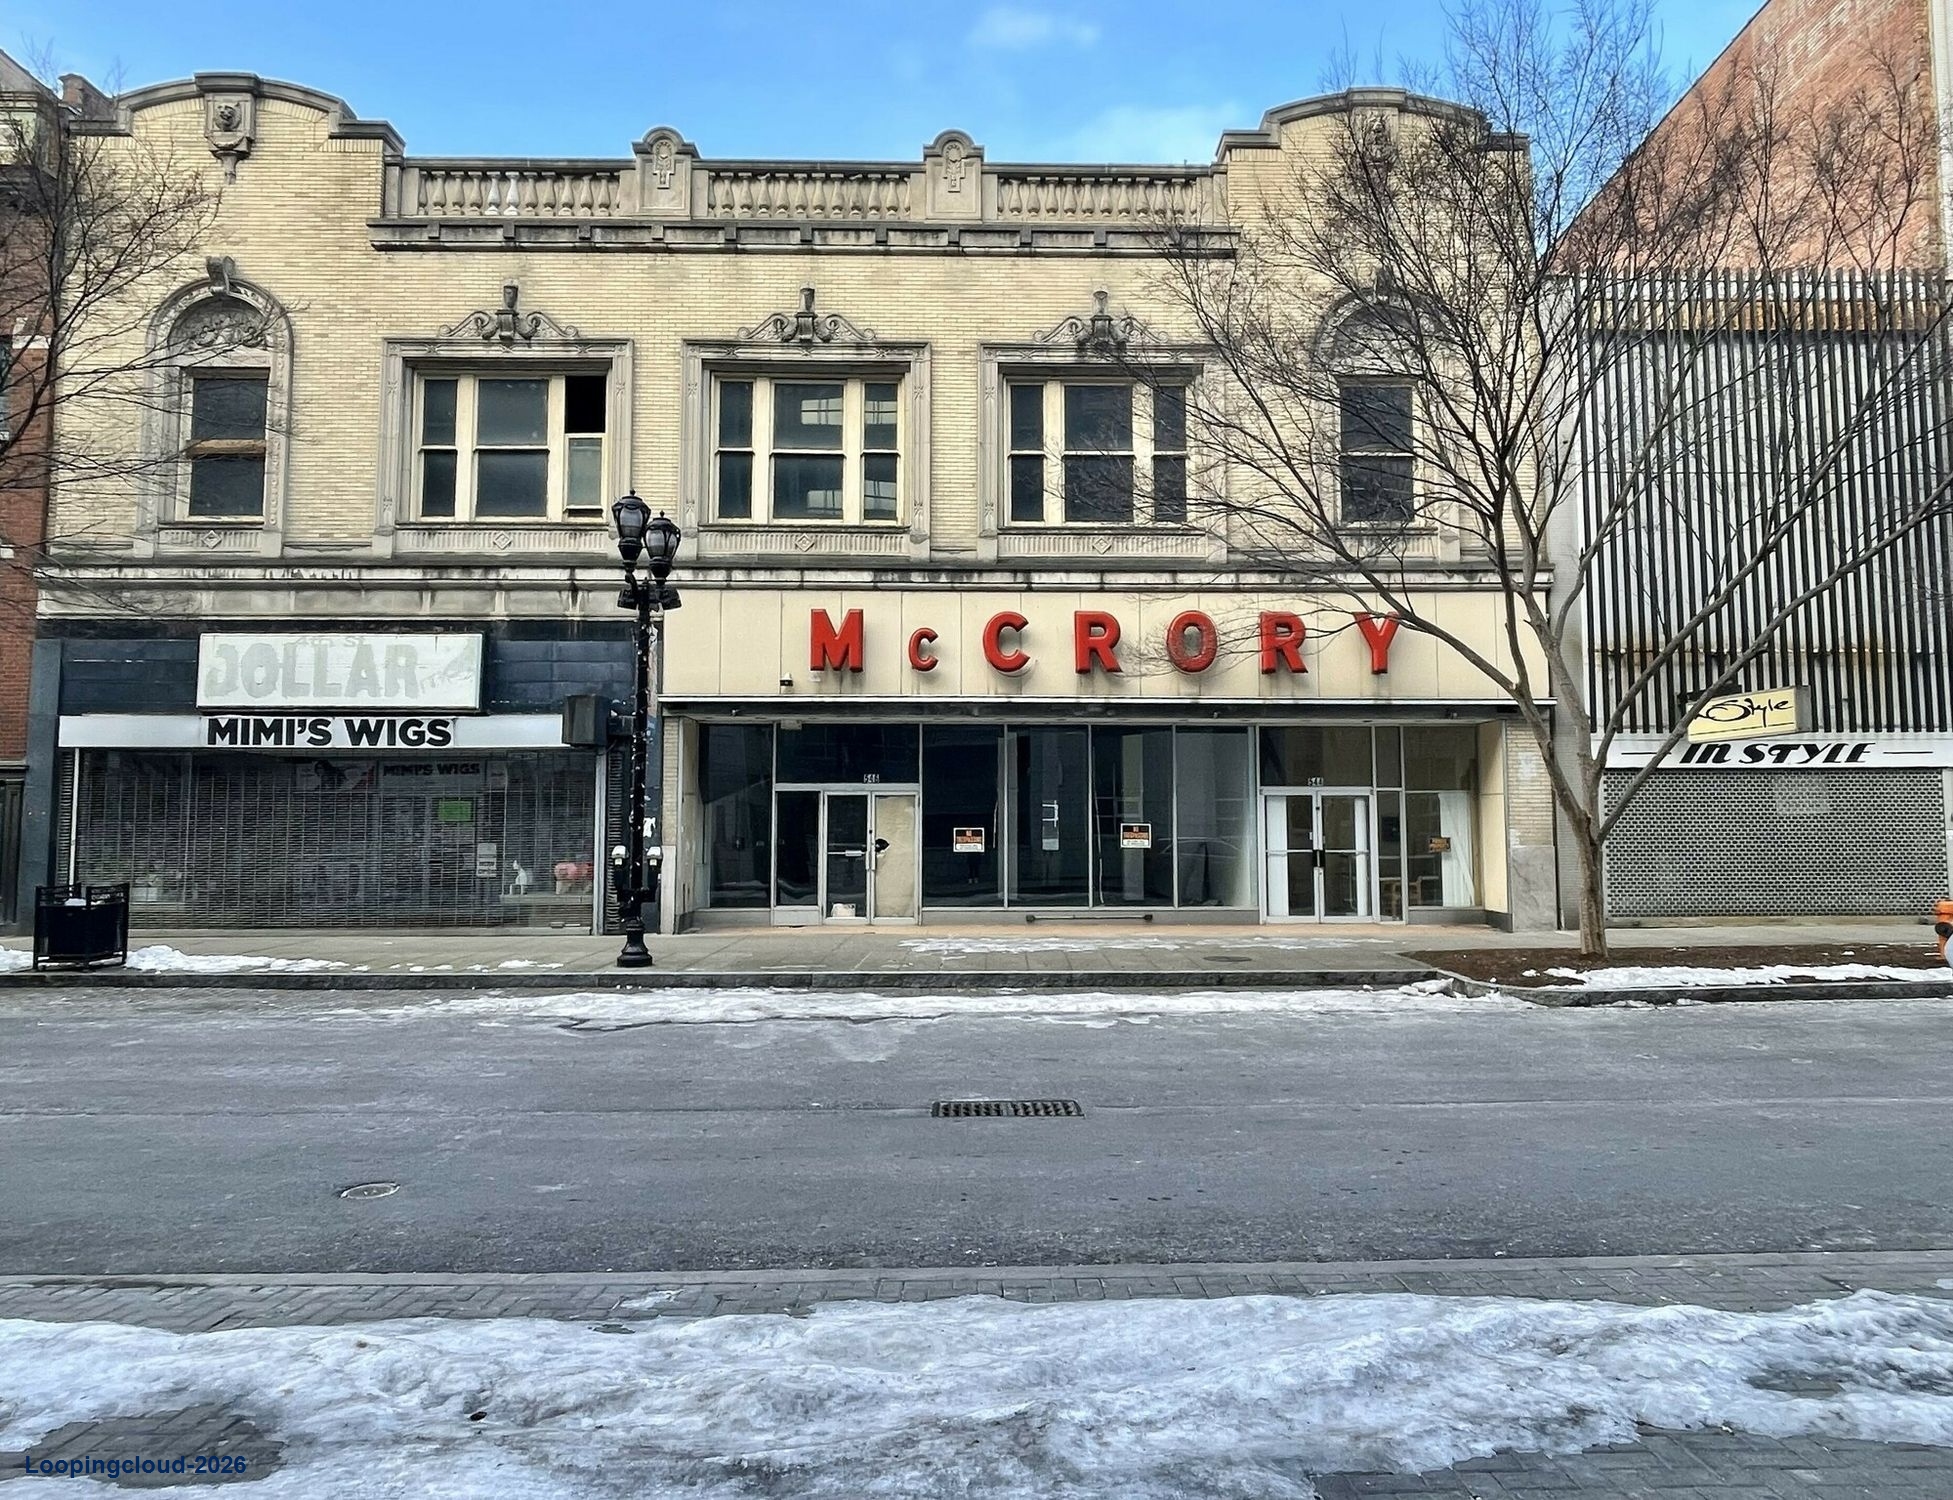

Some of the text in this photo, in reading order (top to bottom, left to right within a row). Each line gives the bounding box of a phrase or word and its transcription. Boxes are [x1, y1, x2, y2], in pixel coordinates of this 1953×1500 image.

[1706, 698, 1794, 728] Style
[207, 717, 452, 747] MIMI'S WIGS
[1738, 742, 1876, 764] STYLE
[437, 763, 480, 775] WIGS
